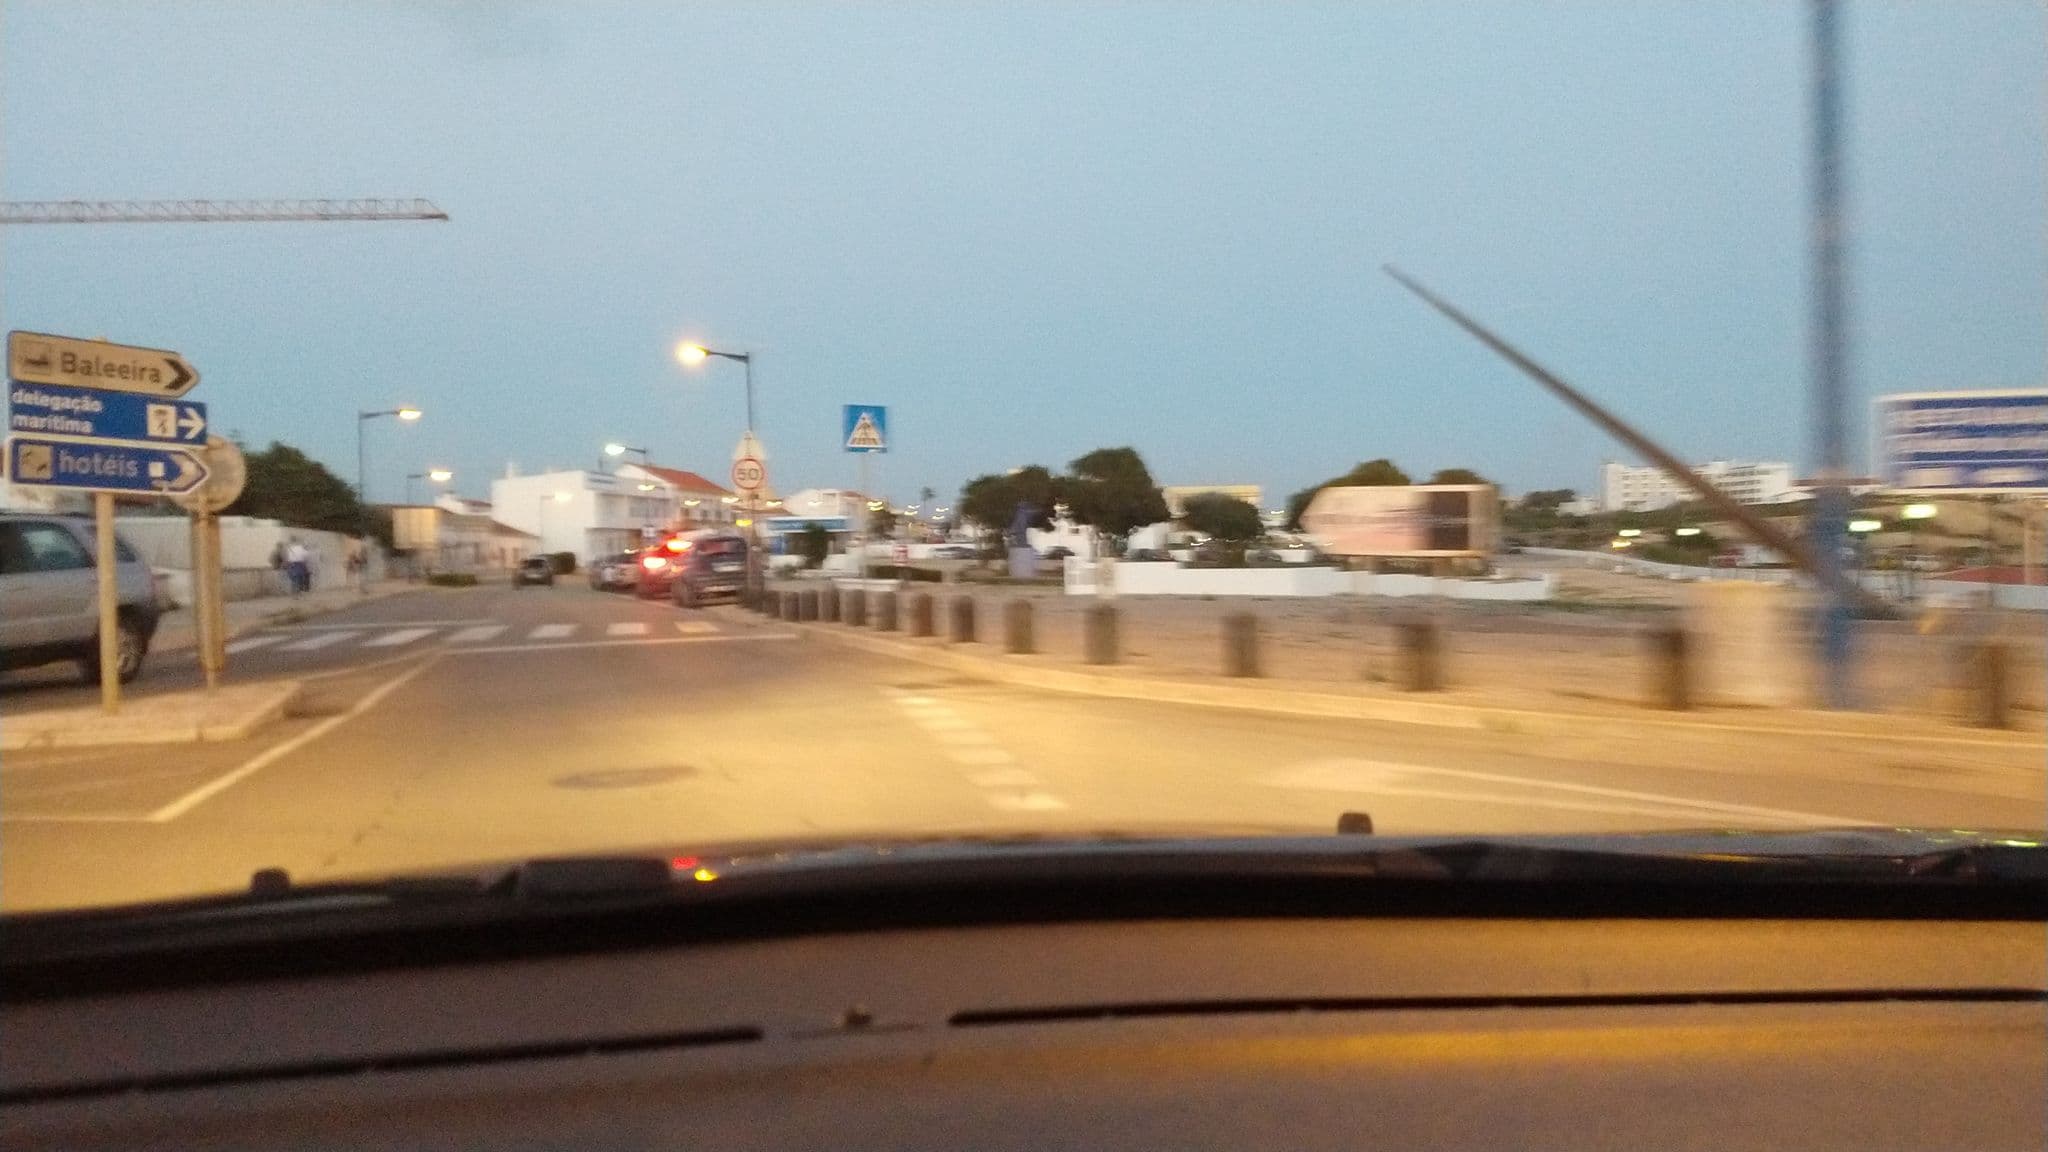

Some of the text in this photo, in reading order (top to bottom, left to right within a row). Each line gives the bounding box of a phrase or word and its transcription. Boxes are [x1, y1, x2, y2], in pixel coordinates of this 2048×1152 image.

[61, 352, 160, 384] Baleeira
[12, 389, 103, 412] delegação
[59, 450, 138, 477] hotéis
[737, 468, 759, 480] 50
